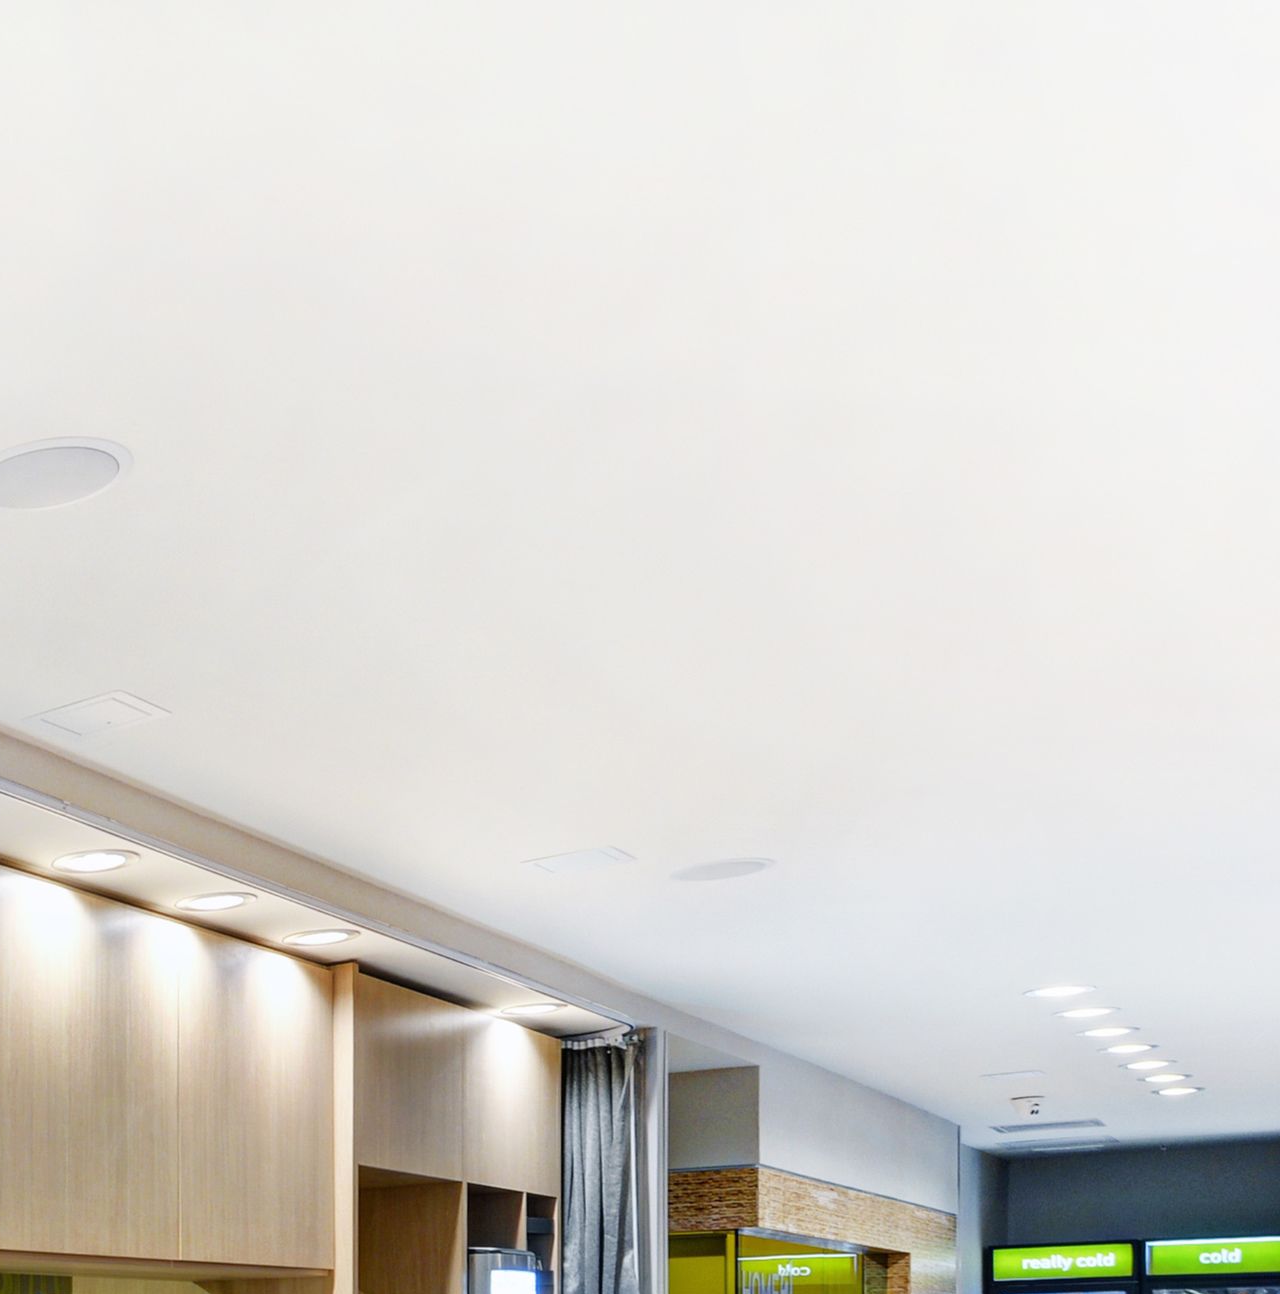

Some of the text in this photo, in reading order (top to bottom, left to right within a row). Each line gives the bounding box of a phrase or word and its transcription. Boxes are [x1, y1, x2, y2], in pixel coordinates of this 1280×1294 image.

[1022, 1253, 1115, 1271] really cold
[1199, 1248, 1241, 1264] cold
